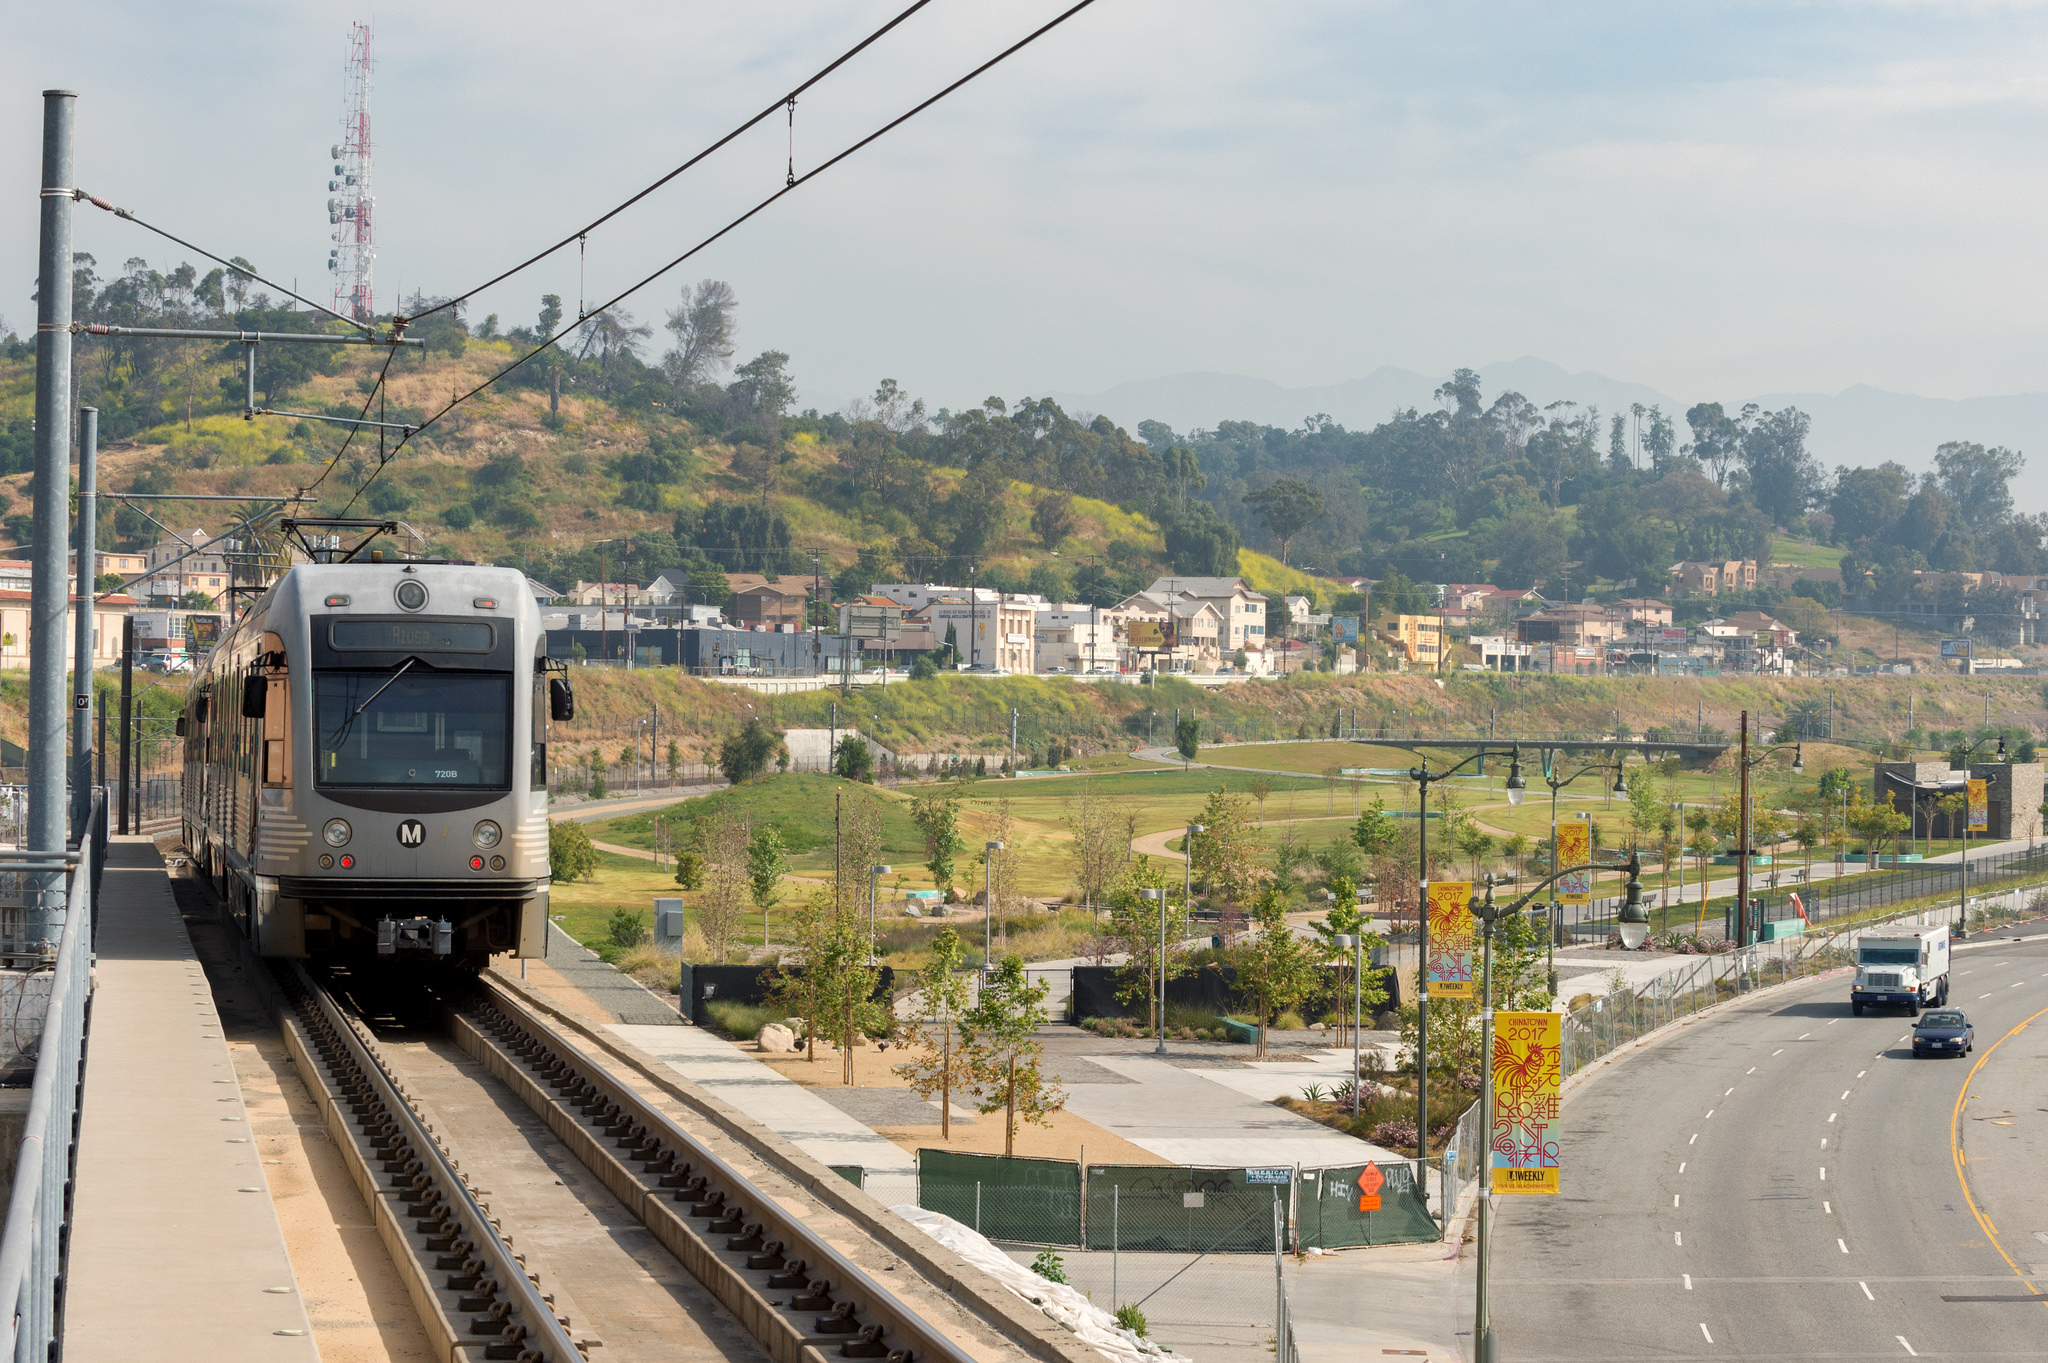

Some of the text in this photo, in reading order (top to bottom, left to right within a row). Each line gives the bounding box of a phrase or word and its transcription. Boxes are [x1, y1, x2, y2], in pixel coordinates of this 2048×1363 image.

[392, 625, 430, 645] Azusa
[434, 770, 458, 778] 720B
[401, 824, 421, 843] M
[1437, 892, 1463, 901] 2017
[1508, 1018, 1548, 1026] CHINATOWN
[1508, 1027, 1547, 1040] 2017
[1517, 1171, 1545, 1181] WEEKLY
